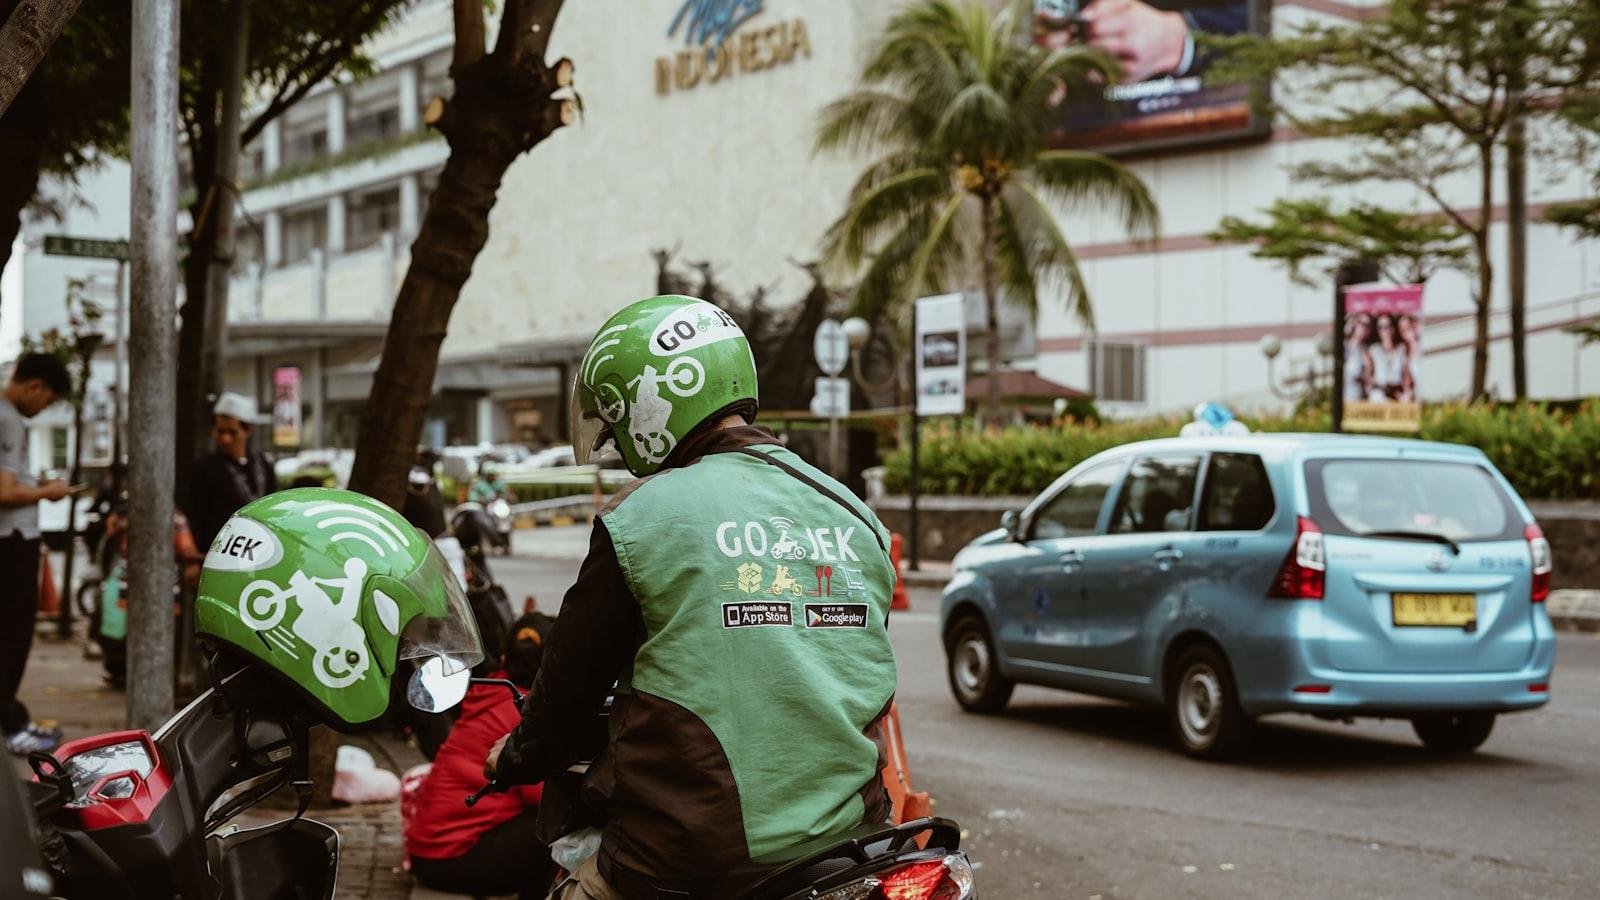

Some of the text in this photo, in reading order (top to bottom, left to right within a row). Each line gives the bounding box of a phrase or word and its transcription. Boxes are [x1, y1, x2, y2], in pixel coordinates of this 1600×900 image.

[654, 18, 811, 96] INDONESIA
[656, 320, 696, 351] GO
[221, 534, 263, 561] JEK
[716, 521, 860, 561] GO JEK
[742, 604, 768, 612] Available
[742, 611, 789, 624] App Store
[822, 612, 864, 625] Google play
